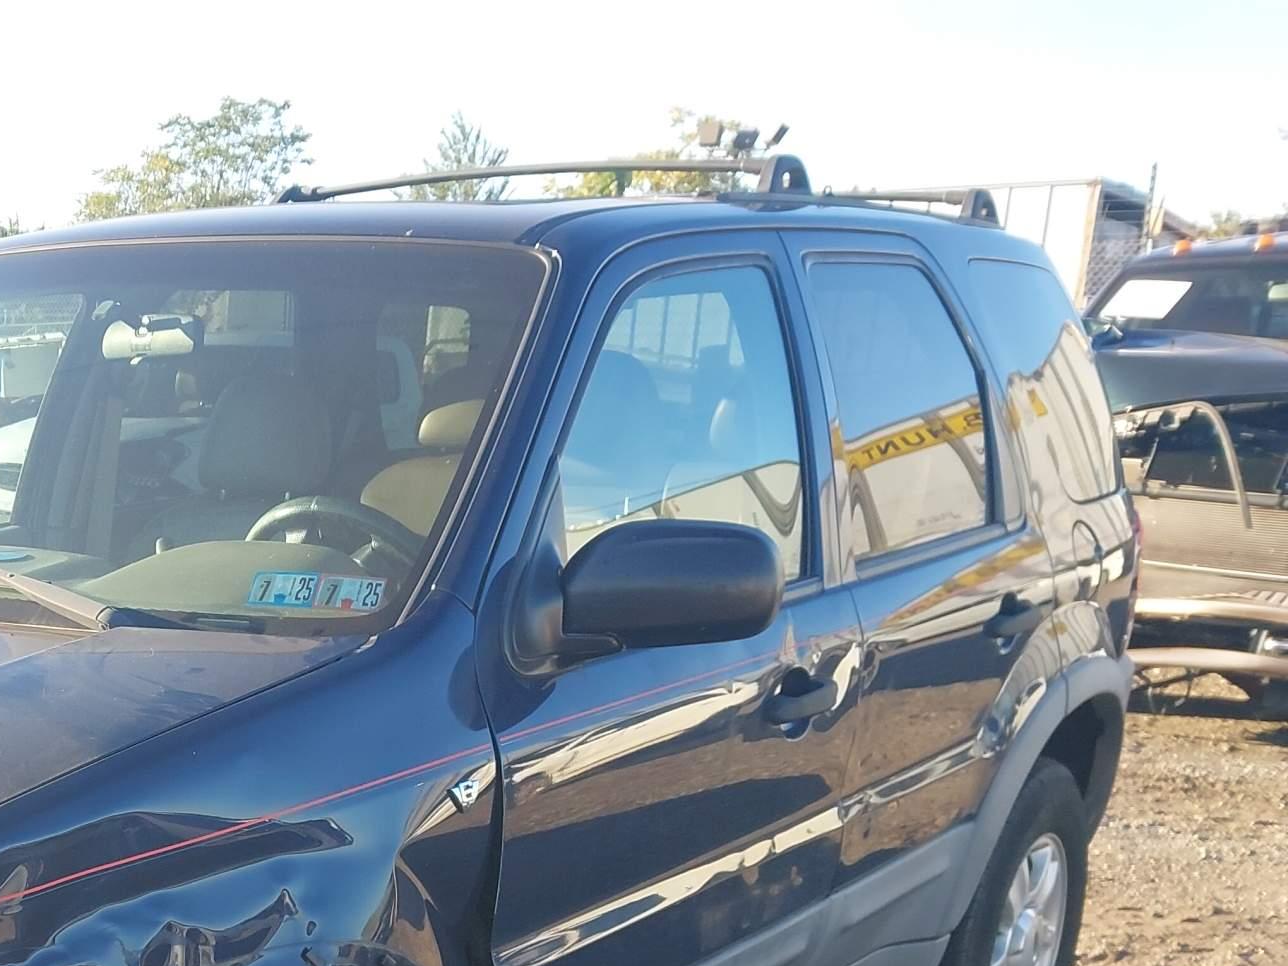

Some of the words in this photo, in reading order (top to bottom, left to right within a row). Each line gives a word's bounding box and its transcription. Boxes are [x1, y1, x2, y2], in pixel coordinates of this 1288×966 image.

[259, 580, 272, 601] 7
[294, 577, 316, 601] 25
[325, 584, 338, 606] 7
[362, 582, 383, 607] 25
